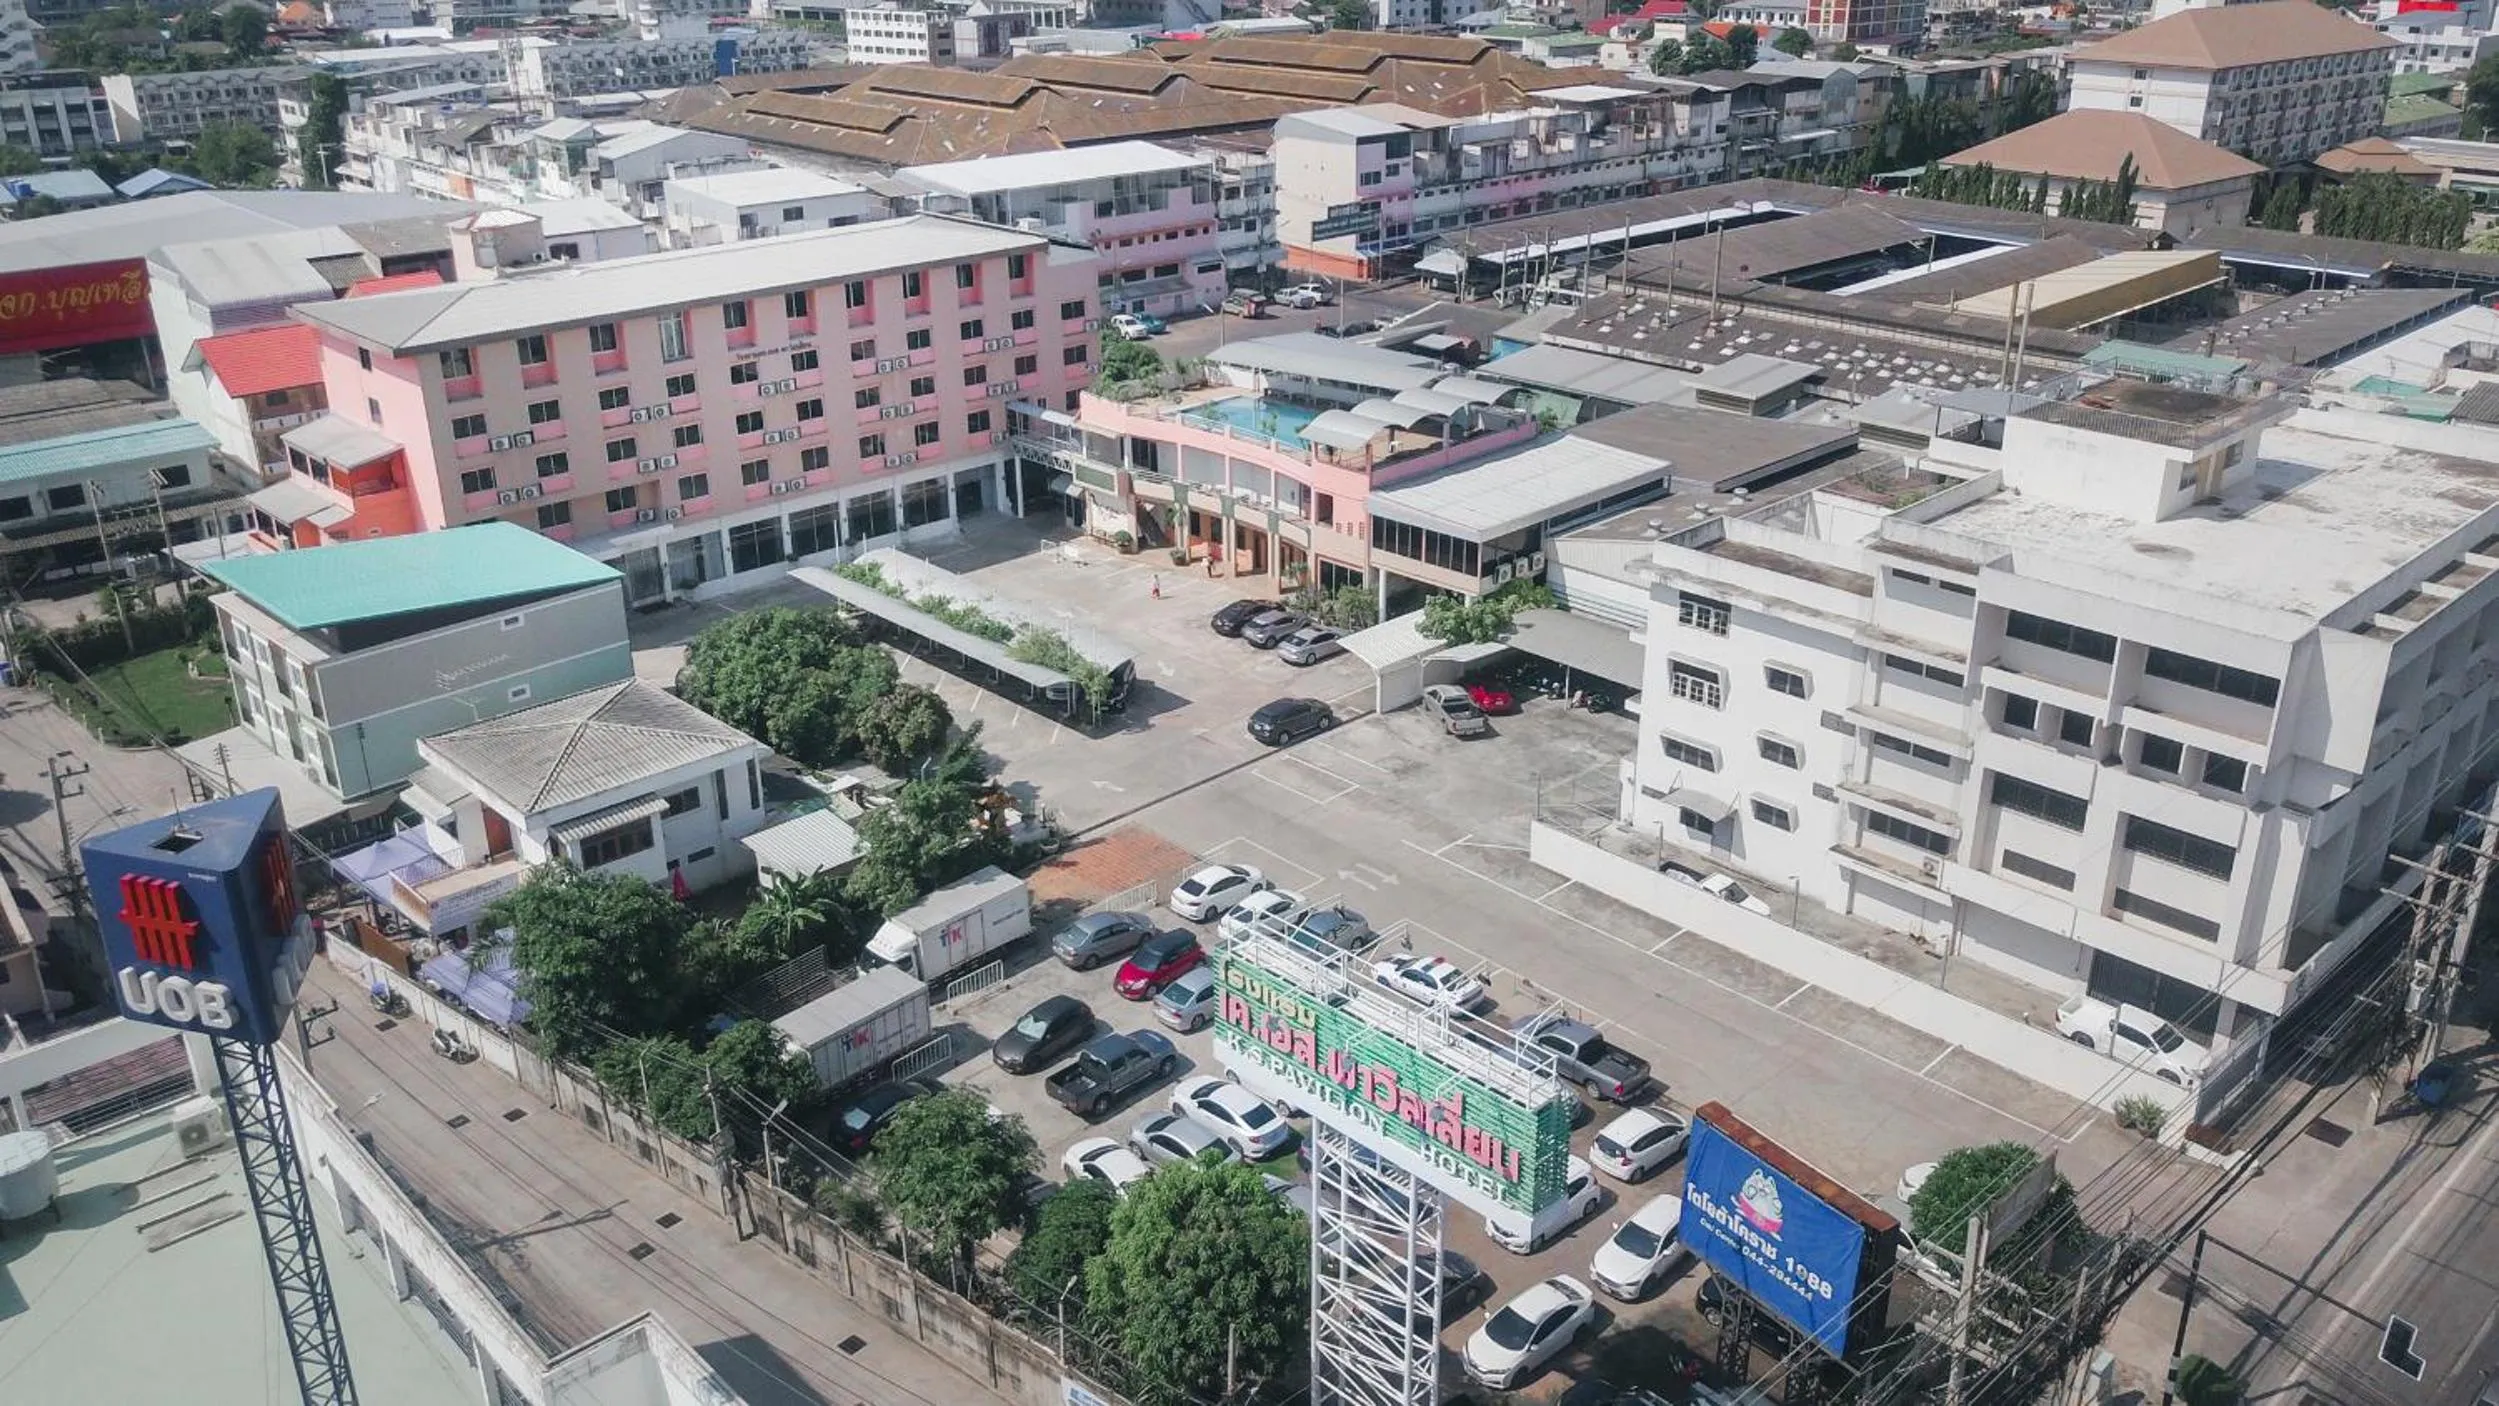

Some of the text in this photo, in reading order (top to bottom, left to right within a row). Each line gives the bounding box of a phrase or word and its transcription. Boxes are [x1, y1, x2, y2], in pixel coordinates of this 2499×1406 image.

[118, 966, 232, 1029] UOB
[1219, 953, 1317, 1031] โรงแรม
[1420, 1140, 1508, 1202] HOTEL
[1785, 1256, 1833, 1300] 1988
